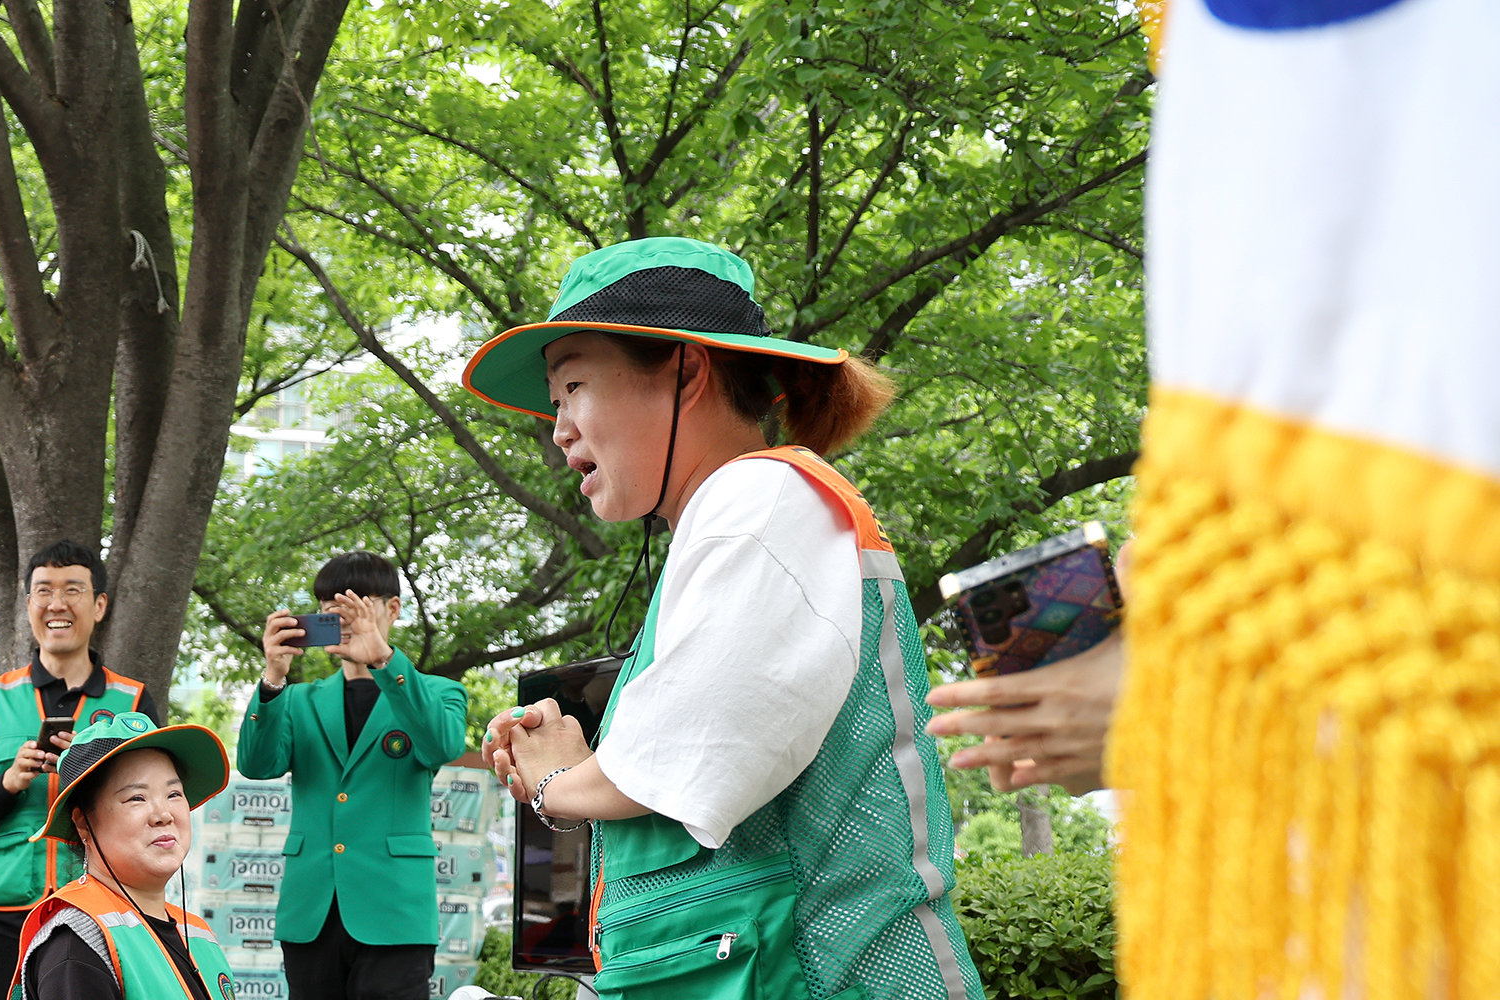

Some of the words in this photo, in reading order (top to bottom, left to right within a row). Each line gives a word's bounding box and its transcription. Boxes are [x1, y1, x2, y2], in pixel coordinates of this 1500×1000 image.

[231, 794, 290, 812] Towel
[231, 861, 282, 878] owel
[229, 916, 276, 934] owel
[235, 981, 284, 998] Towe
